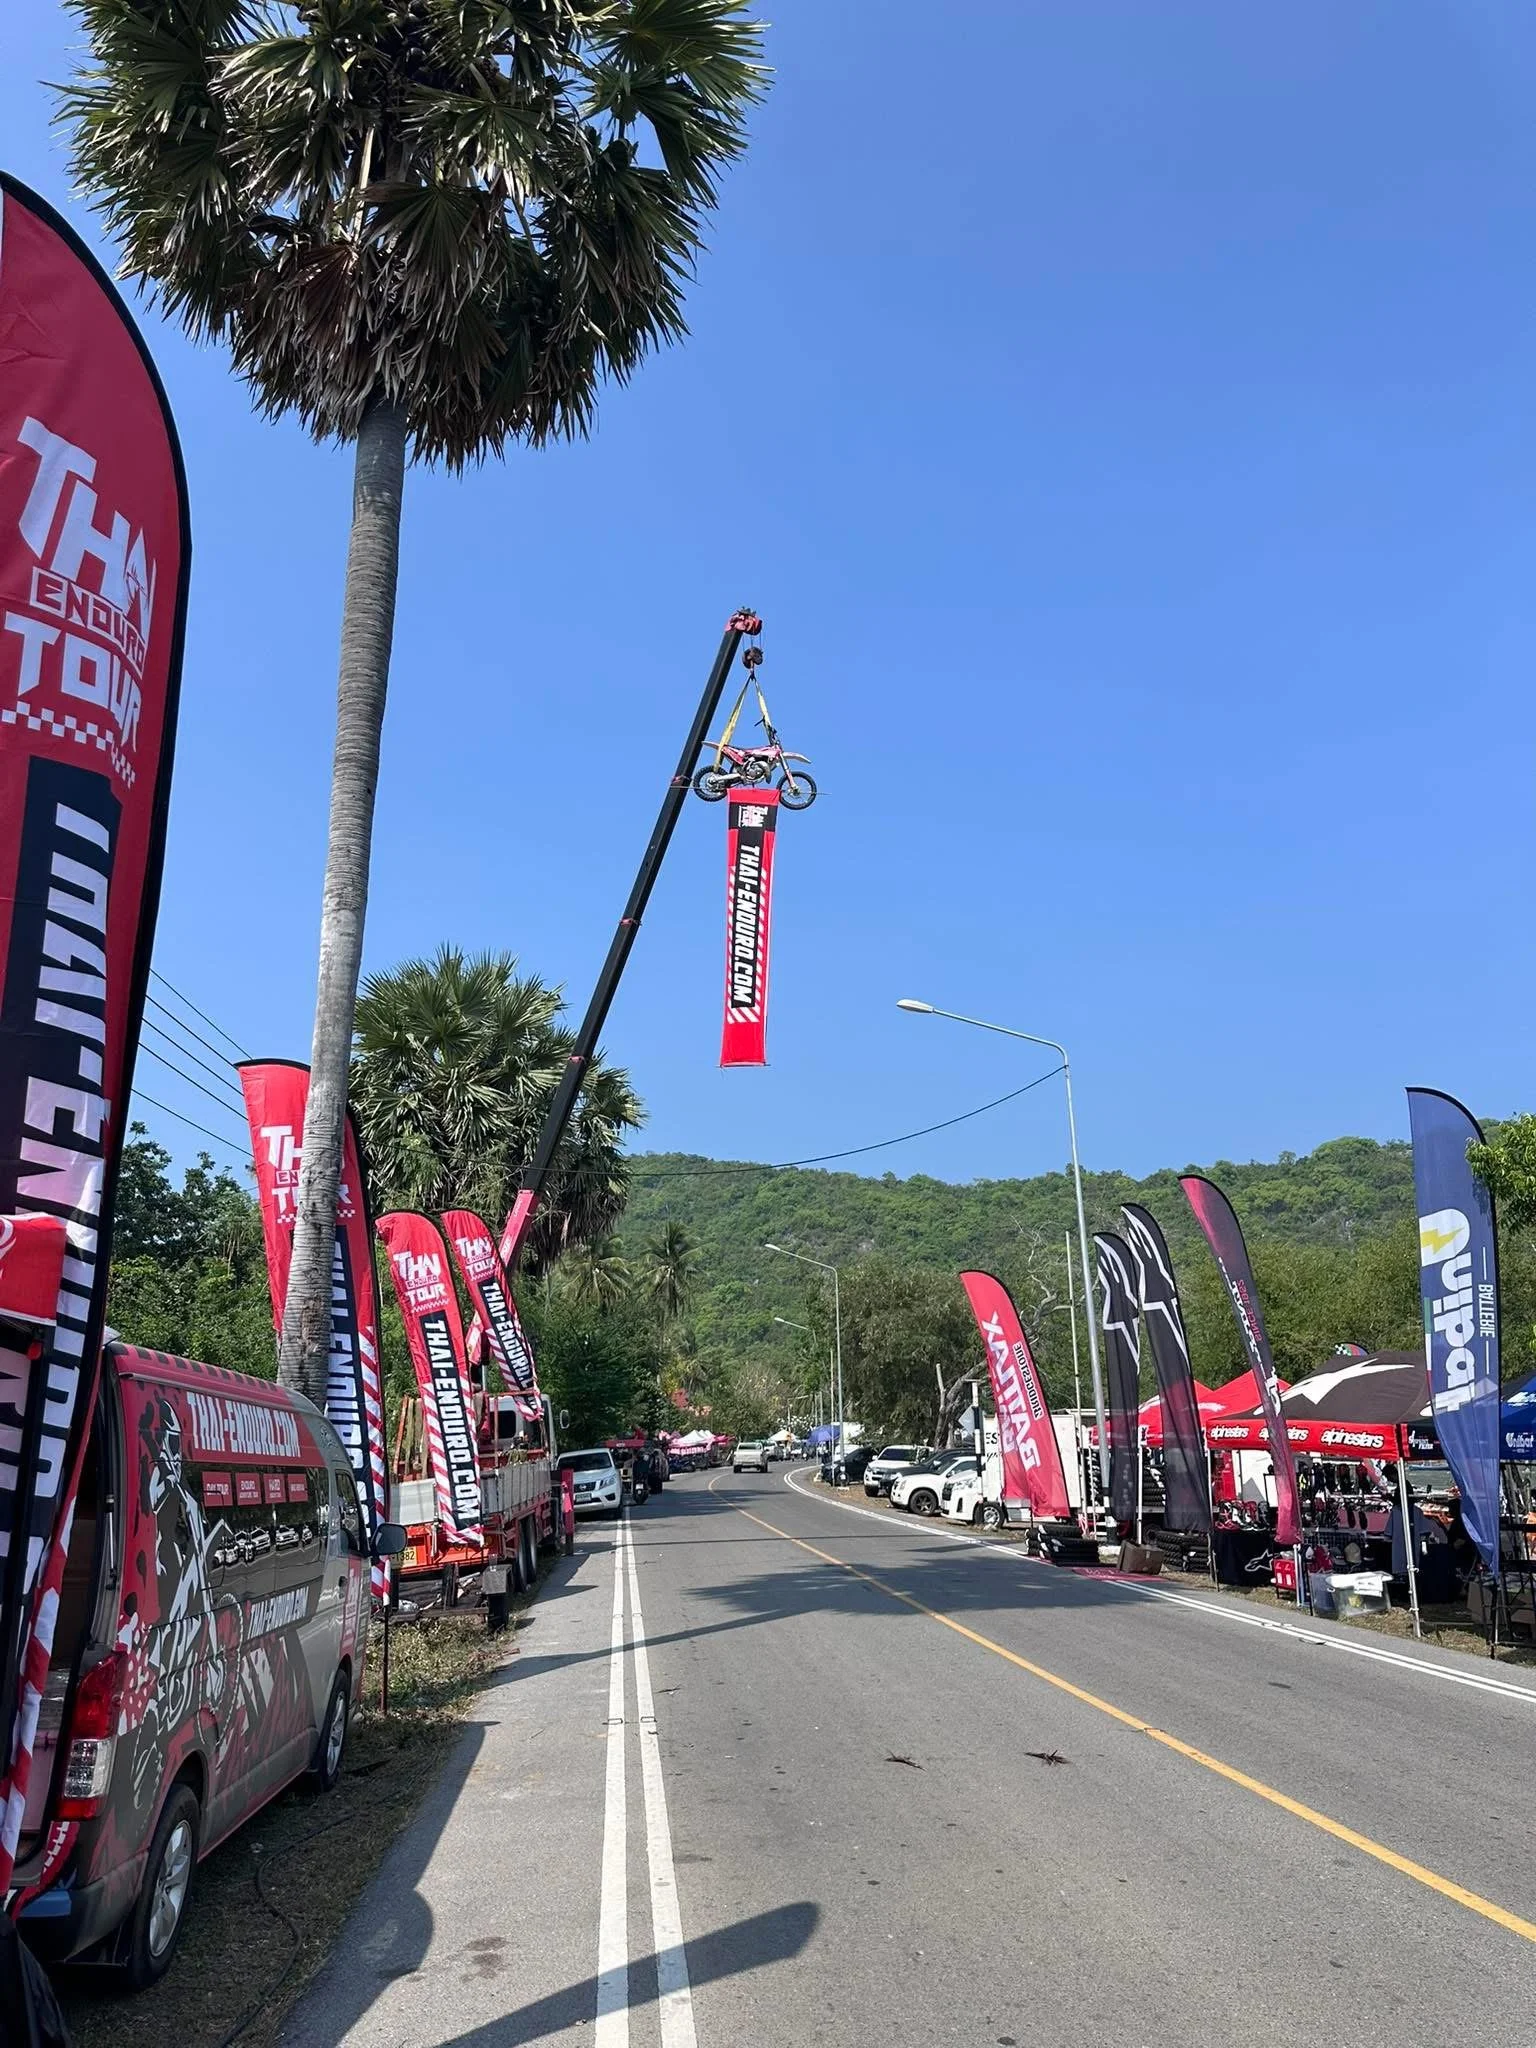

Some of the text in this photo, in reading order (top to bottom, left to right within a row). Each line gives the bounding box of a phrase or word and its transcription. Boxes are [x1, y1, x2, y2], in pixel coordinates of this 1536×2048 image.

[29, 566, 146, 680] ENDURO
[4, 611, 143, 753] TOUR
[733, 845, 760, 1004] THAI-ENDURO.COM
[393, 1251, 441, 1282] THAI
[405, 1283, 447, 1307] TOUR
[187, 1391, 301, 1458] THAI-ENDURO.COM
[424, 1319, 480, 1519] THAI-ENDURO.COM
[1321, 1428, 1383, 1448] alpinestars
